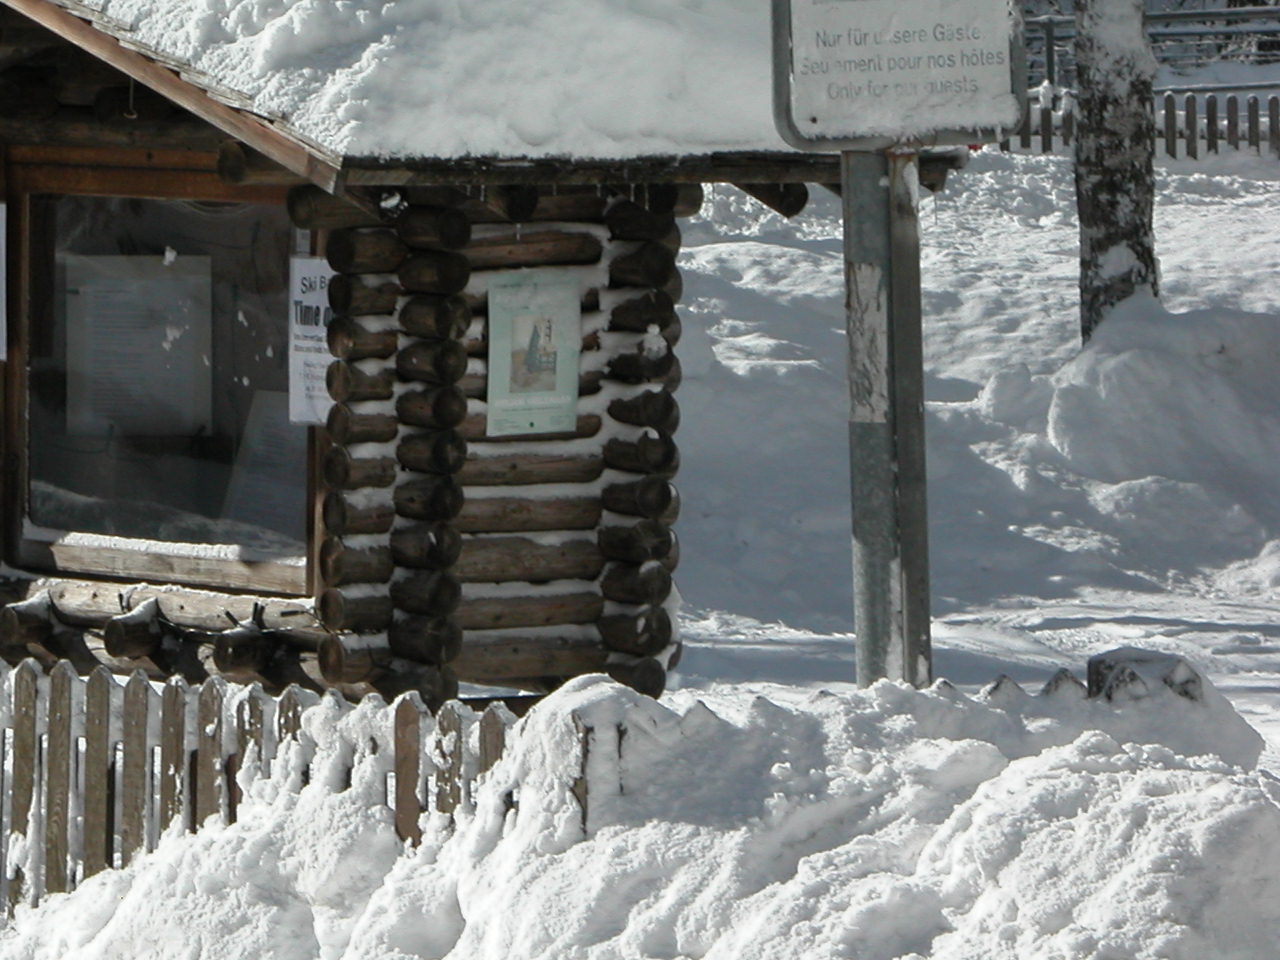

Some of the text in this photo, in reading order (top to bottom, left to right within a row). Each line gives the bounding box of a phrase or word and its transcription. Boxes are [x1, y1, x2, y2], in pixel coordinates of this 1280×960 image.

[815, 30, 843, 48] Nur
[847, 27, 870, 47] für
[873, 27, 928, 45] usere
[800, 48, 1006, 76] Seument pour nos hôtes
[826, 81, 863, 100] Only
[866, 79, 889, 98] for
[926, 75, 980, 95] guests
[300, 275, 318, 294] Ski
[293, 299, 321, 327] Time
